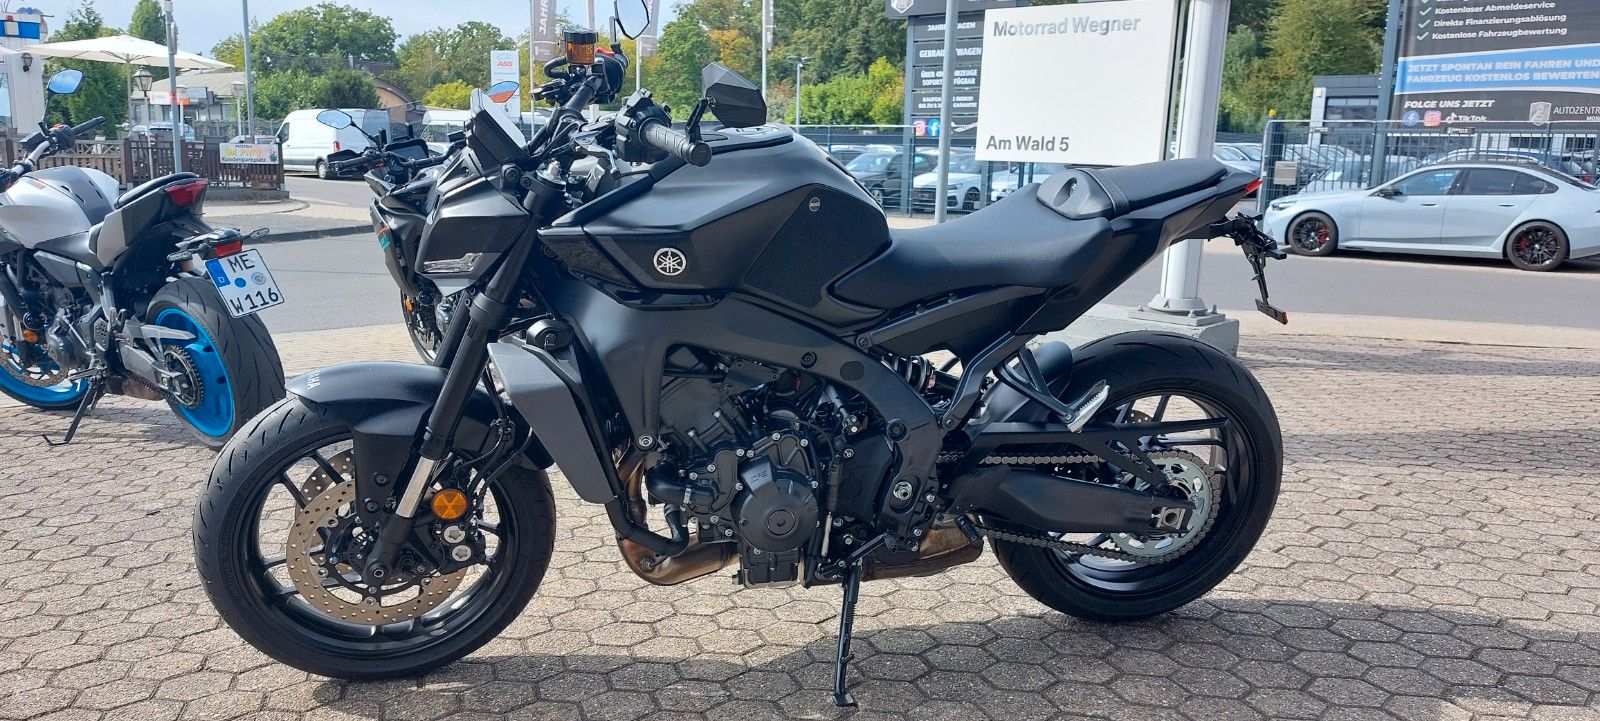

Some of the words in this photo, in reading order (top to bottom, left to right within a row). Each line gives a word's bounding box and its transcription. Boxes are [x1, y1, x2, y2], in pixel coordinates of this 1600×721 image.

[1435, 6, 1482, 15] Kostenloser
[1485, 1, 1555, 13] Abmeldeservice
[993, 18, 1068, 37] Motorrad
[1072, 16, 1141, 35] Wegner
[1433, 18, 1464, 27] Direkte
[1466, 13, 1567, 26] Finanzierungsablösung
[1432, 31, 1477, 40] Kostenlose
[1478, 27, 1567, 38] Fahrzeugbewertung
[1408, 63, 1438, 73] JETZT
[1441, 62, 1493, 72] SPONTAN
[1495, 61, 1521, 70] REIN
[1524, 60, 1572, 69] FAHREN
[1574, 59, 1600, 68] UND
[1407, 74, 1462, 84] FAHRZEUG
[1465, 72, 1529, 82] KOSTENLOS
[1532, 71, 1600, 81] BEWERTEN
[1404, 101, 1437, 109] FOLGE
[1461, 100, 1495, 108] JETZT
[1458, 114, 1487, 122] TikTok
[986, 135, 1012, 150] Am
[1015, 135, 1055, 151] Wald
[1059, 137, 1070, 152] 5
[227, 254, 255, 273] ME
